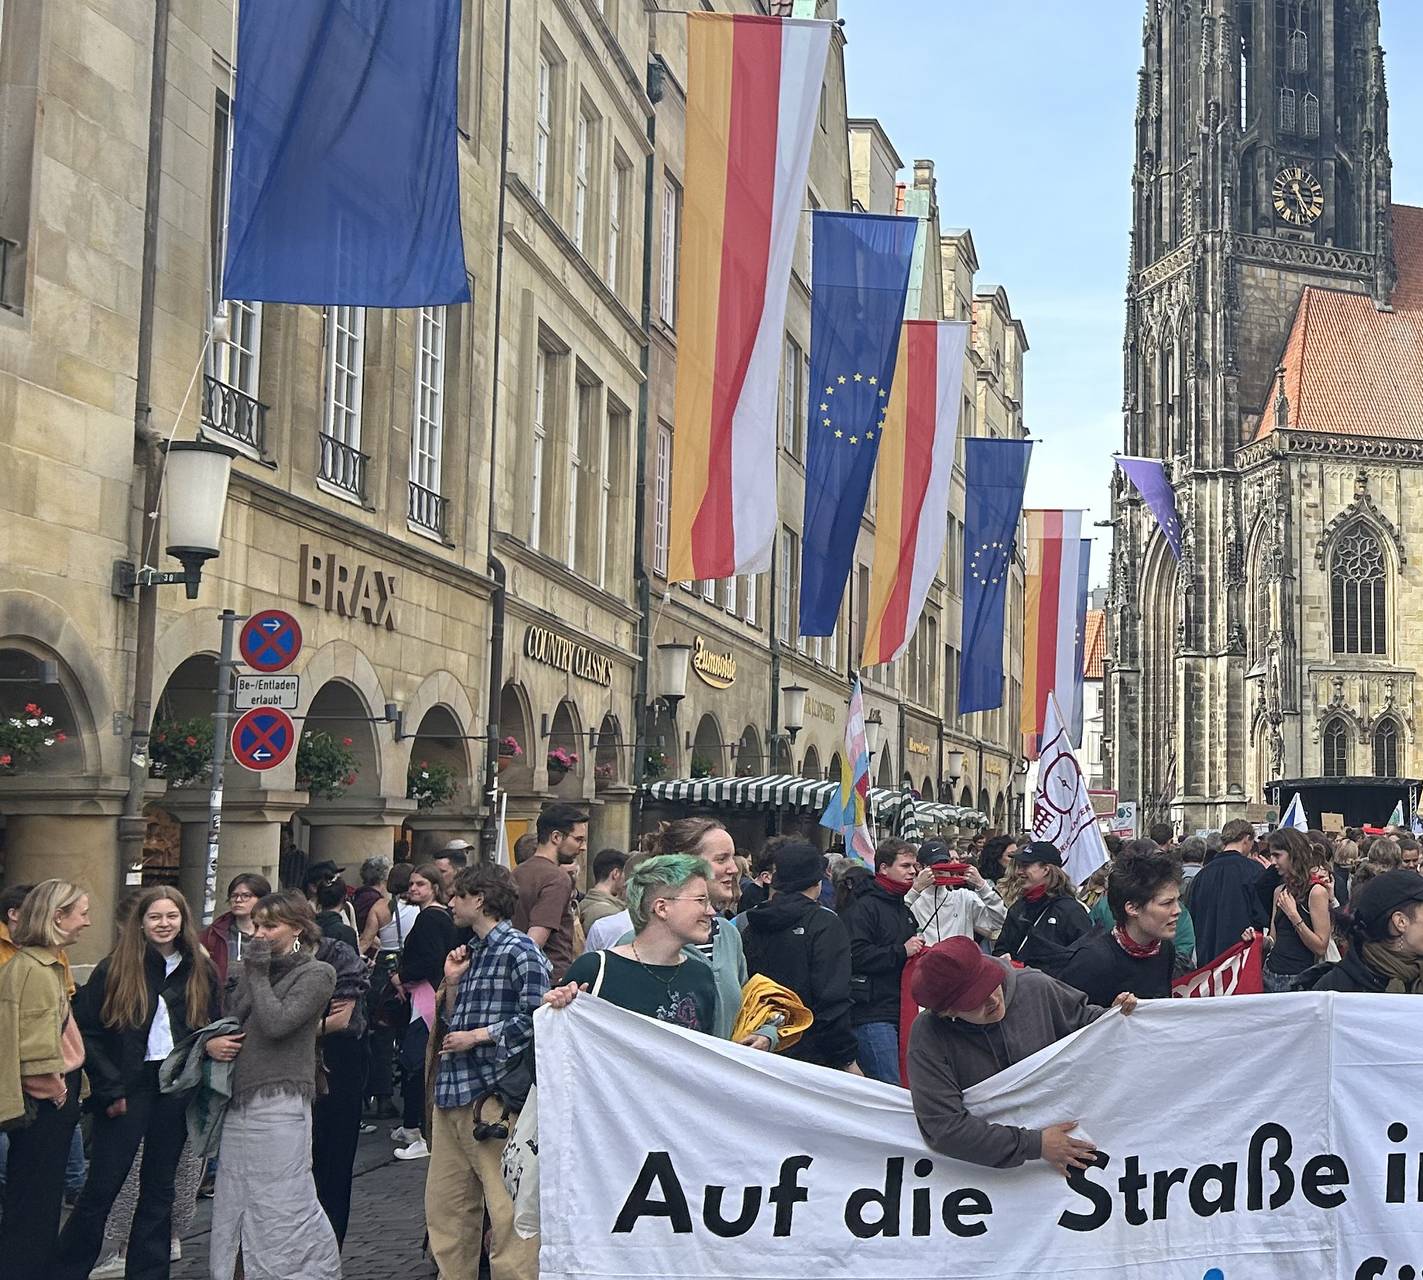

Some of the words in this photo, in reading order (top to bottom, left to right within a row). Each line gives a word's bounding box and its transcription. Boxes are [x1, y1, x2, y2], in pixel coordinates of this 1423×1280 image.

[299, 543, 398, 631] BRAX
[238, 678, 297, 692] Be-/Entladen
[525, 624, 576, 673] COUNTRY
[573, 644, 613, 688] CLASSICS
[250, 693, 282, 705] erlaubt
[611, 1150, 813, 1238] Auf
[843, 1156, 993, 1239] die
[1058, 1122, 1348, 1232] Straße
